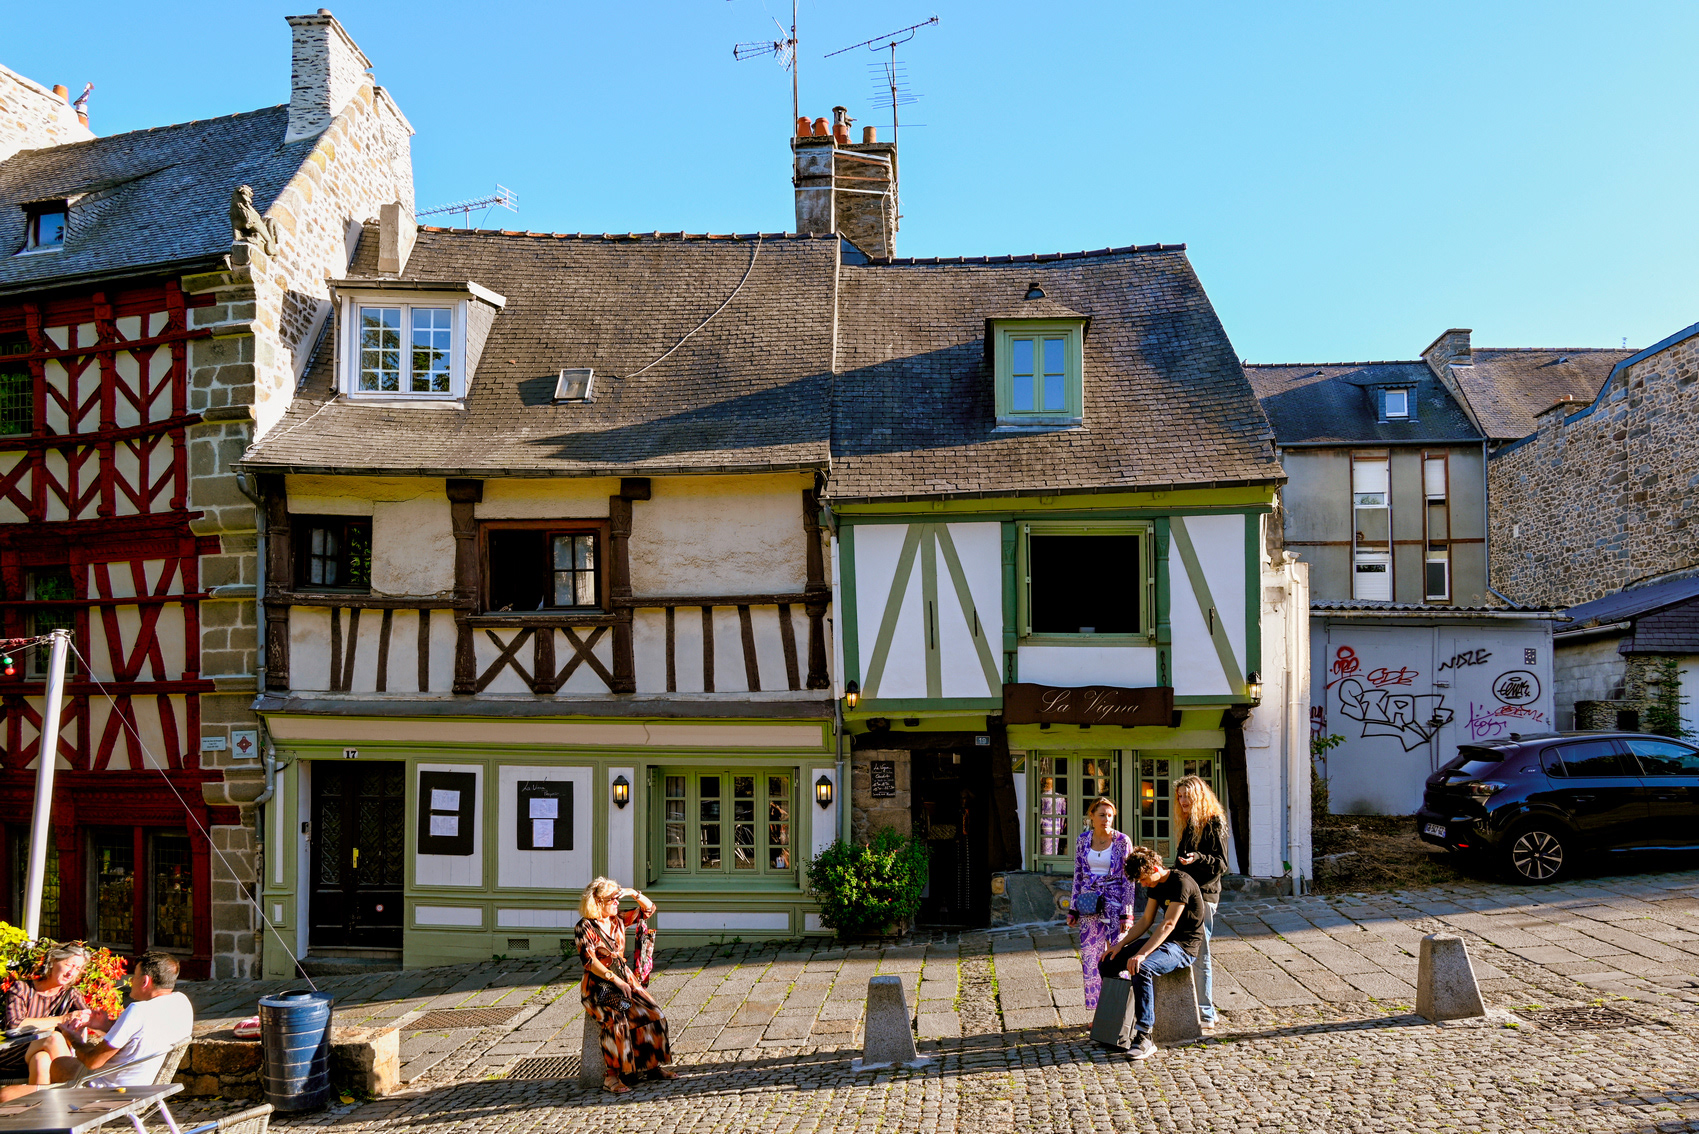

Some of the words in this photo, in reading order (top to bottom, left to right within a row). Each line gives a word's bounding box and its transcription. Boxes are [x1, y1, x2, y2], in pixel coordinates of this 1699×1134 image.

[1040, 690, 1071, 713] La
[1084, 690, 1139, 723] Vigna
[345, 750, 357, 759] 17
